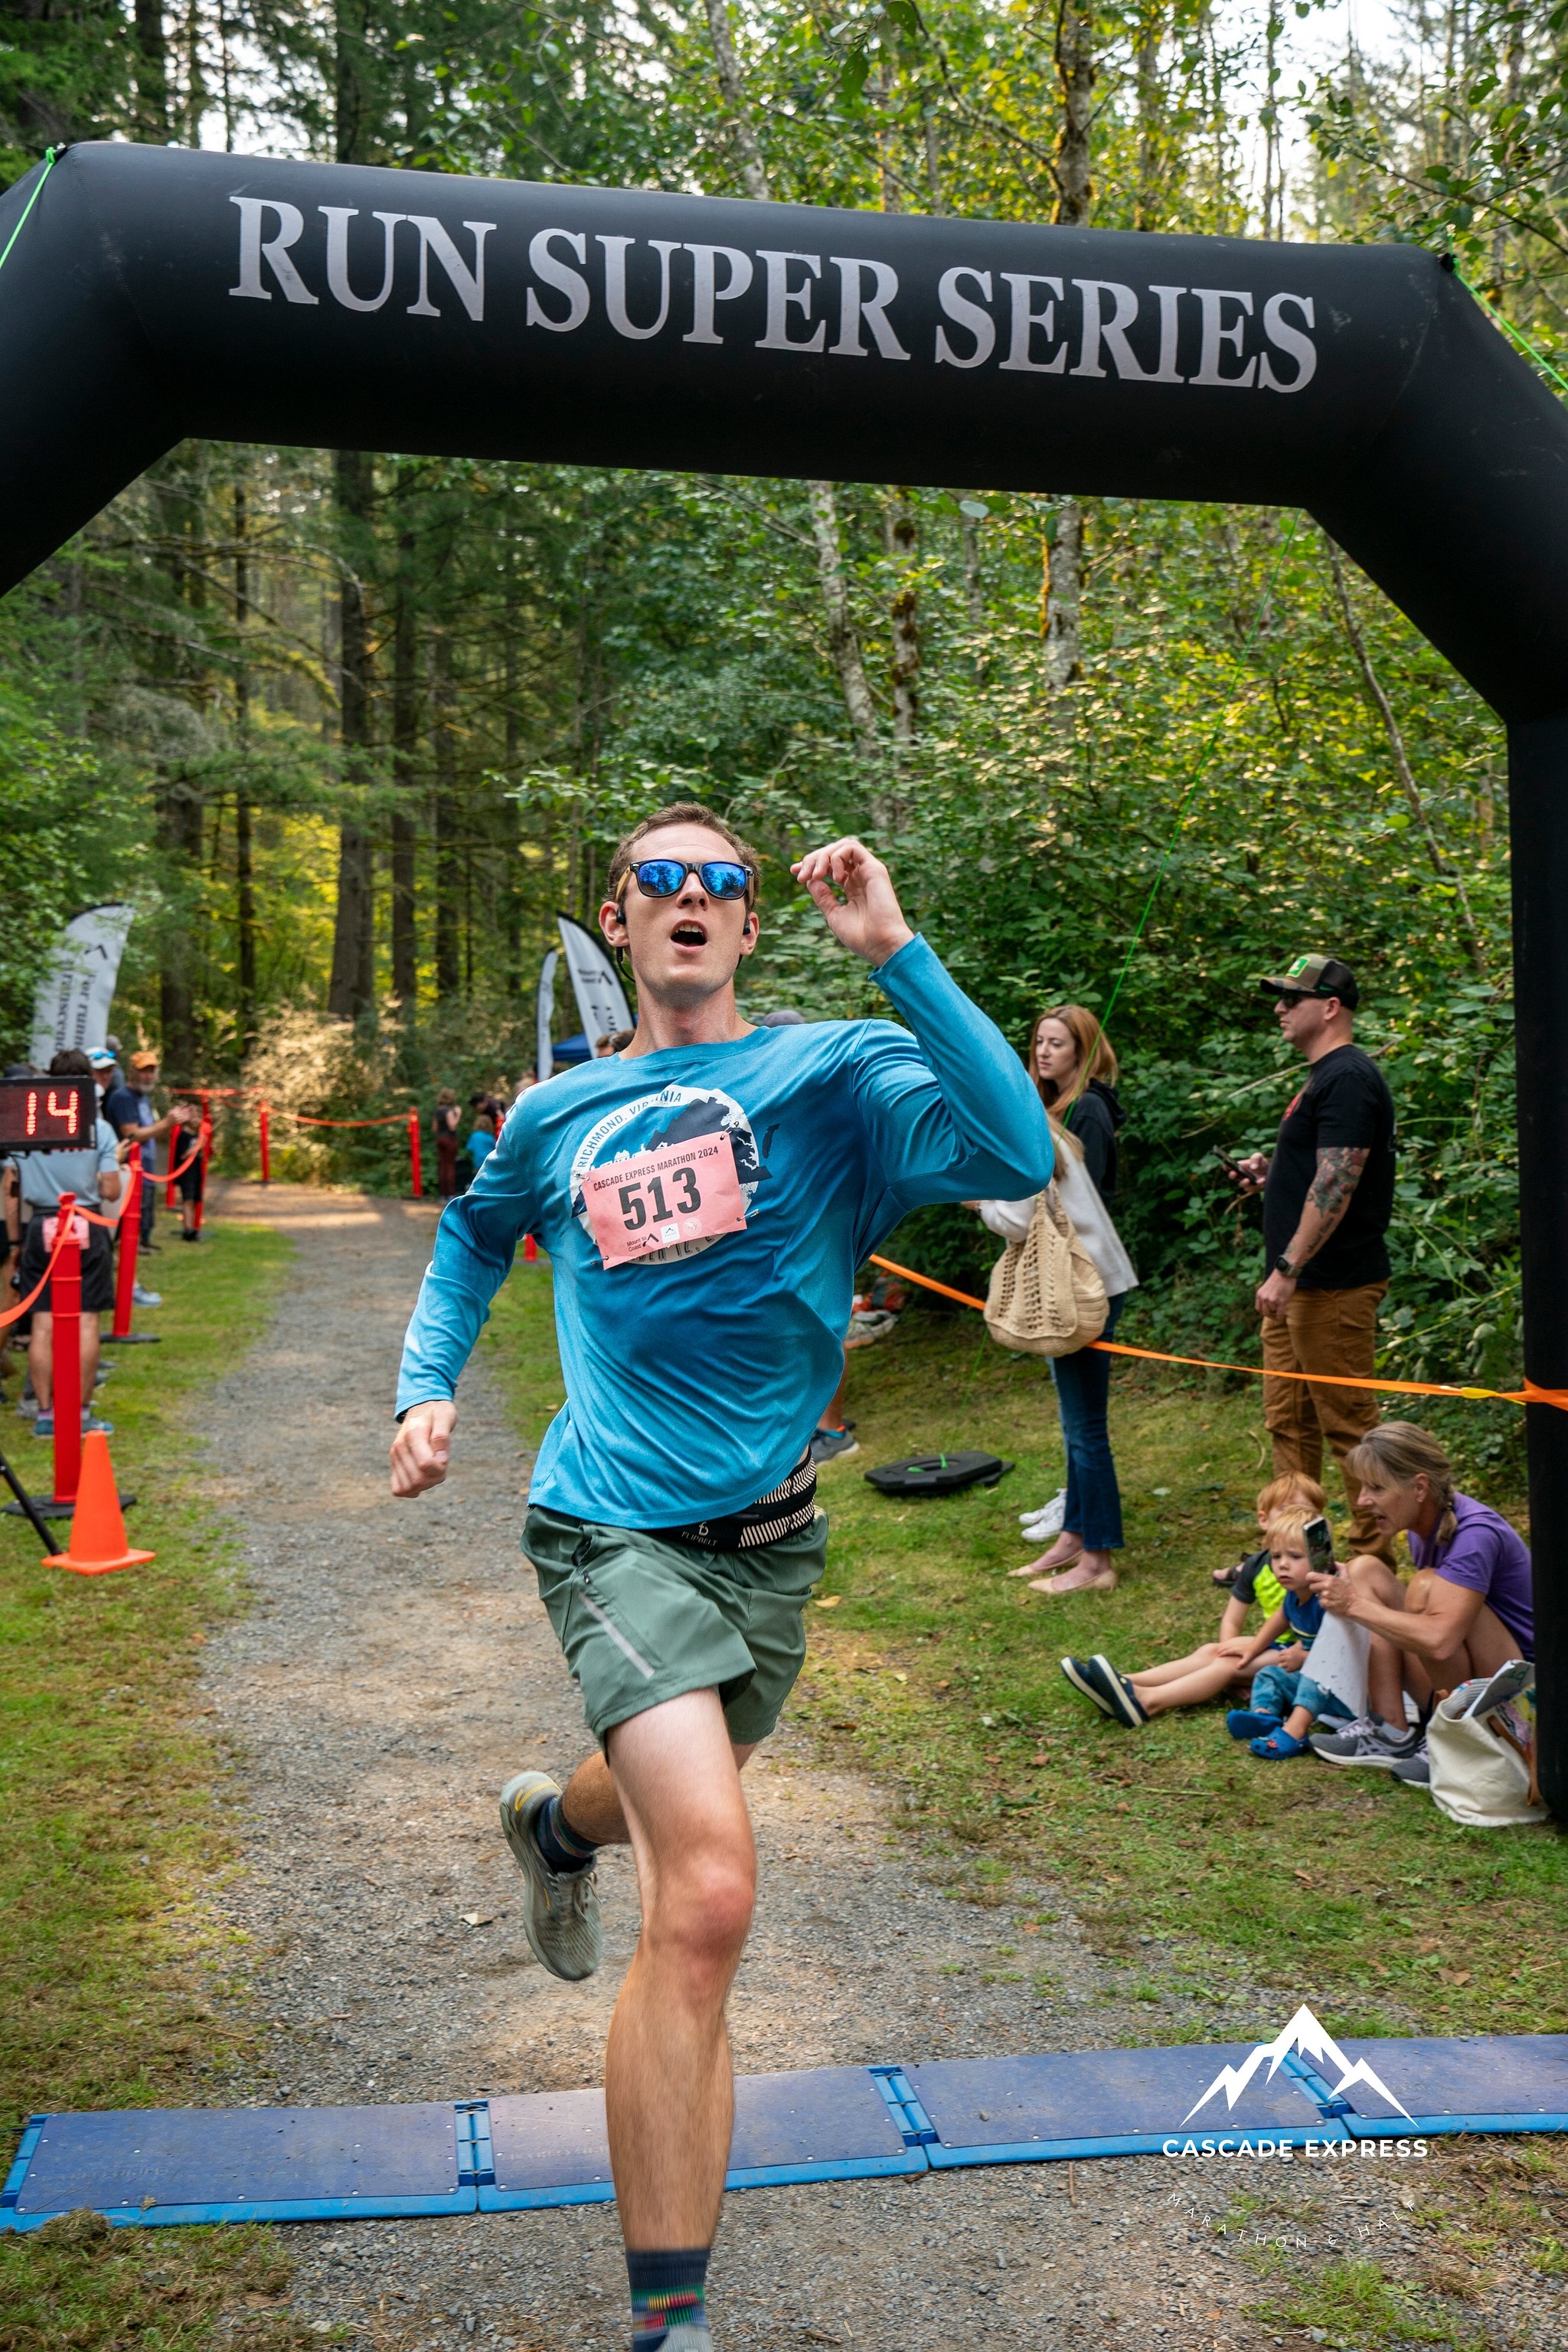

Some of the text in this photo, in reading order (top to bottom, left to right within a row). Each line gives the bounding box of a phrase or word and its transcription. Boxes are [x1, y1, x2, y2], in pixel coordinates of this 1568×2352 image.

[229, 196, 1318, 393] RUN SUPER SERIES
[26, 1090, 78, 1135] 14
[593, 1145, 719, 1191] CASCADE EXPRESS MARATHON 2024
[618, 1167, 702, 1231] 513
[626, 1237, 641, 1247] Mount
[628, 1243, 642, 1252] Coast
